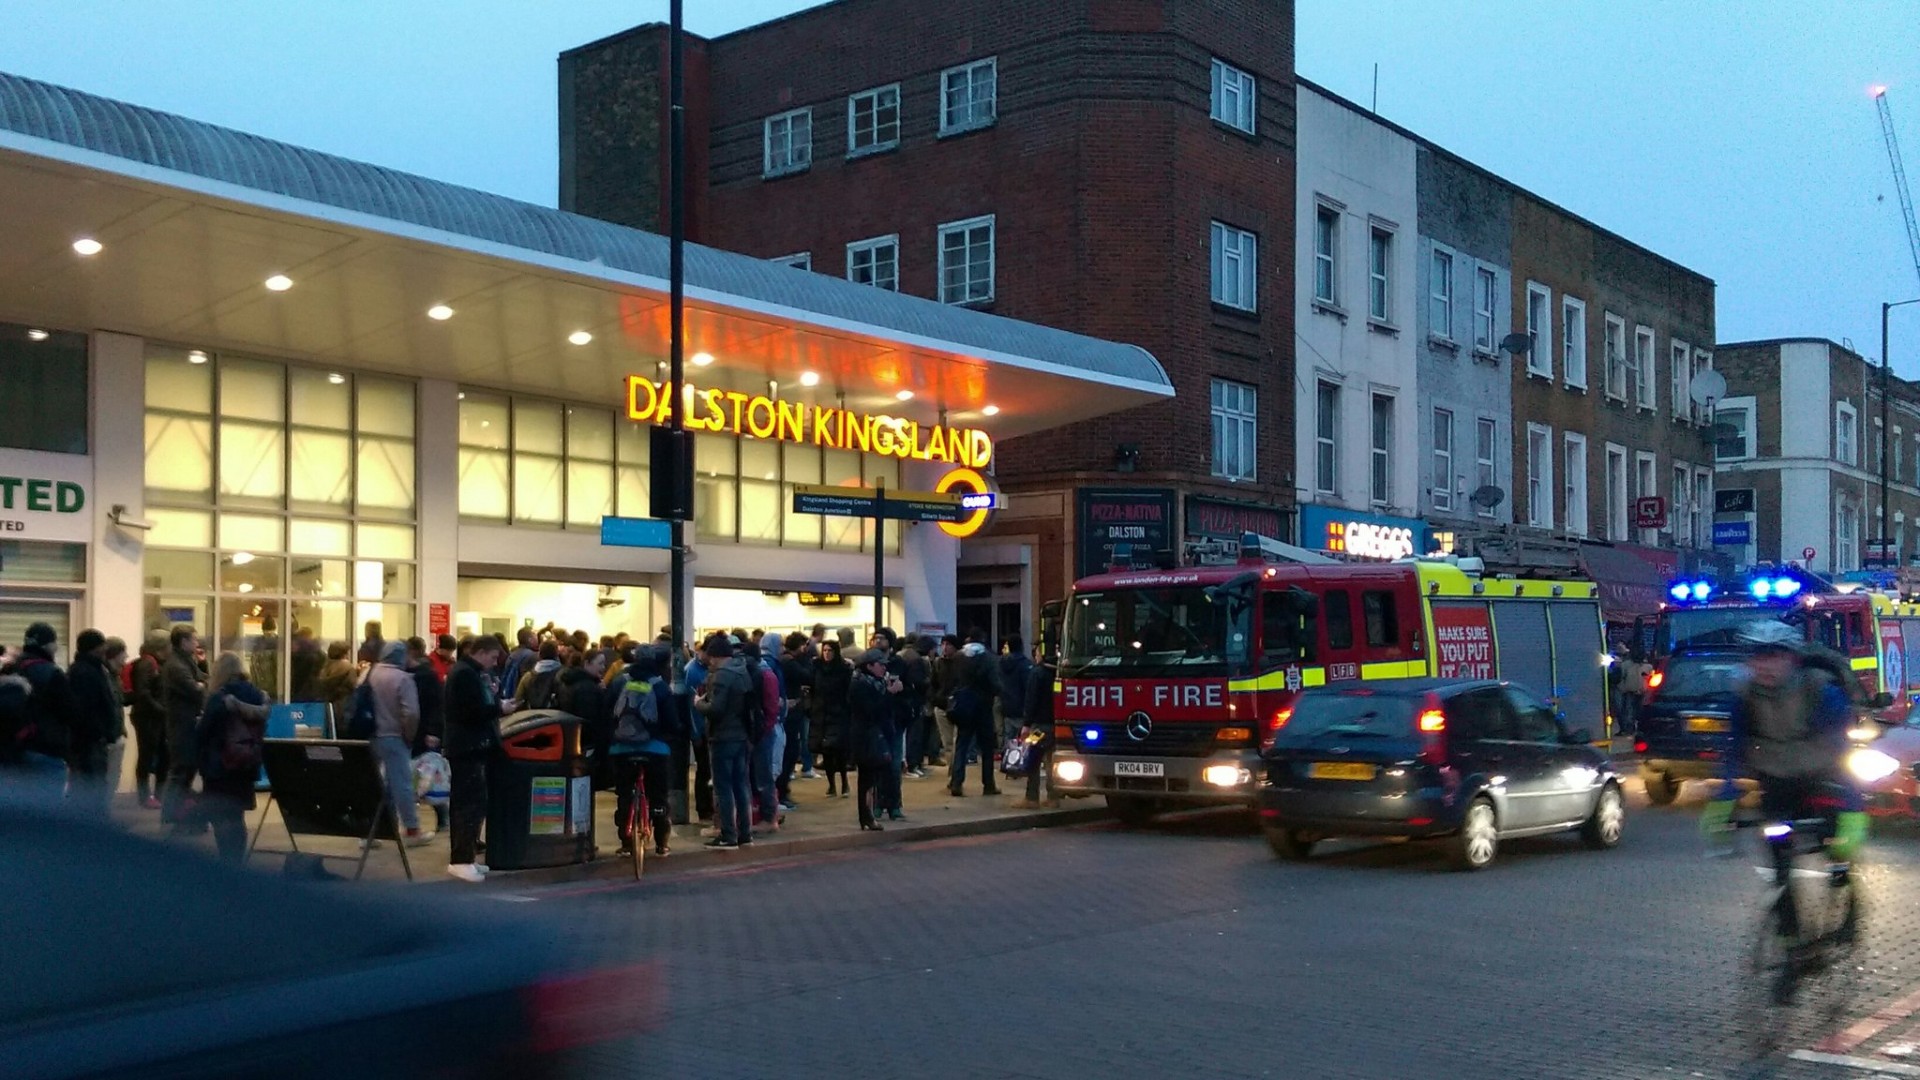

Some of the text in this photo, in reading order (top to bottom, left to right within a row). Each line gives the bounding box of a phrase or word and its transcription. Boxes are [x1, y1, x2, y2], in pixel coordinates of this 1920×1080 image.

[629, 374, 993, 468] DALSTON KINGSLAND
[1108, 526, 1145, 538] DALSTON
[1345, 521, 1413, 560] GREGGS
[1114, 574, 1199, 585] www.london-fire.gov.uk
[1438, 626, 1489, 641] MAKE SURE
[1441, 642, 1489, 662] YOU PUT
[1441, 664, 1455, 678] IT
[1154, 685, 1223, 707] FIRE
[1118, 763, 1141, 773] RK04
